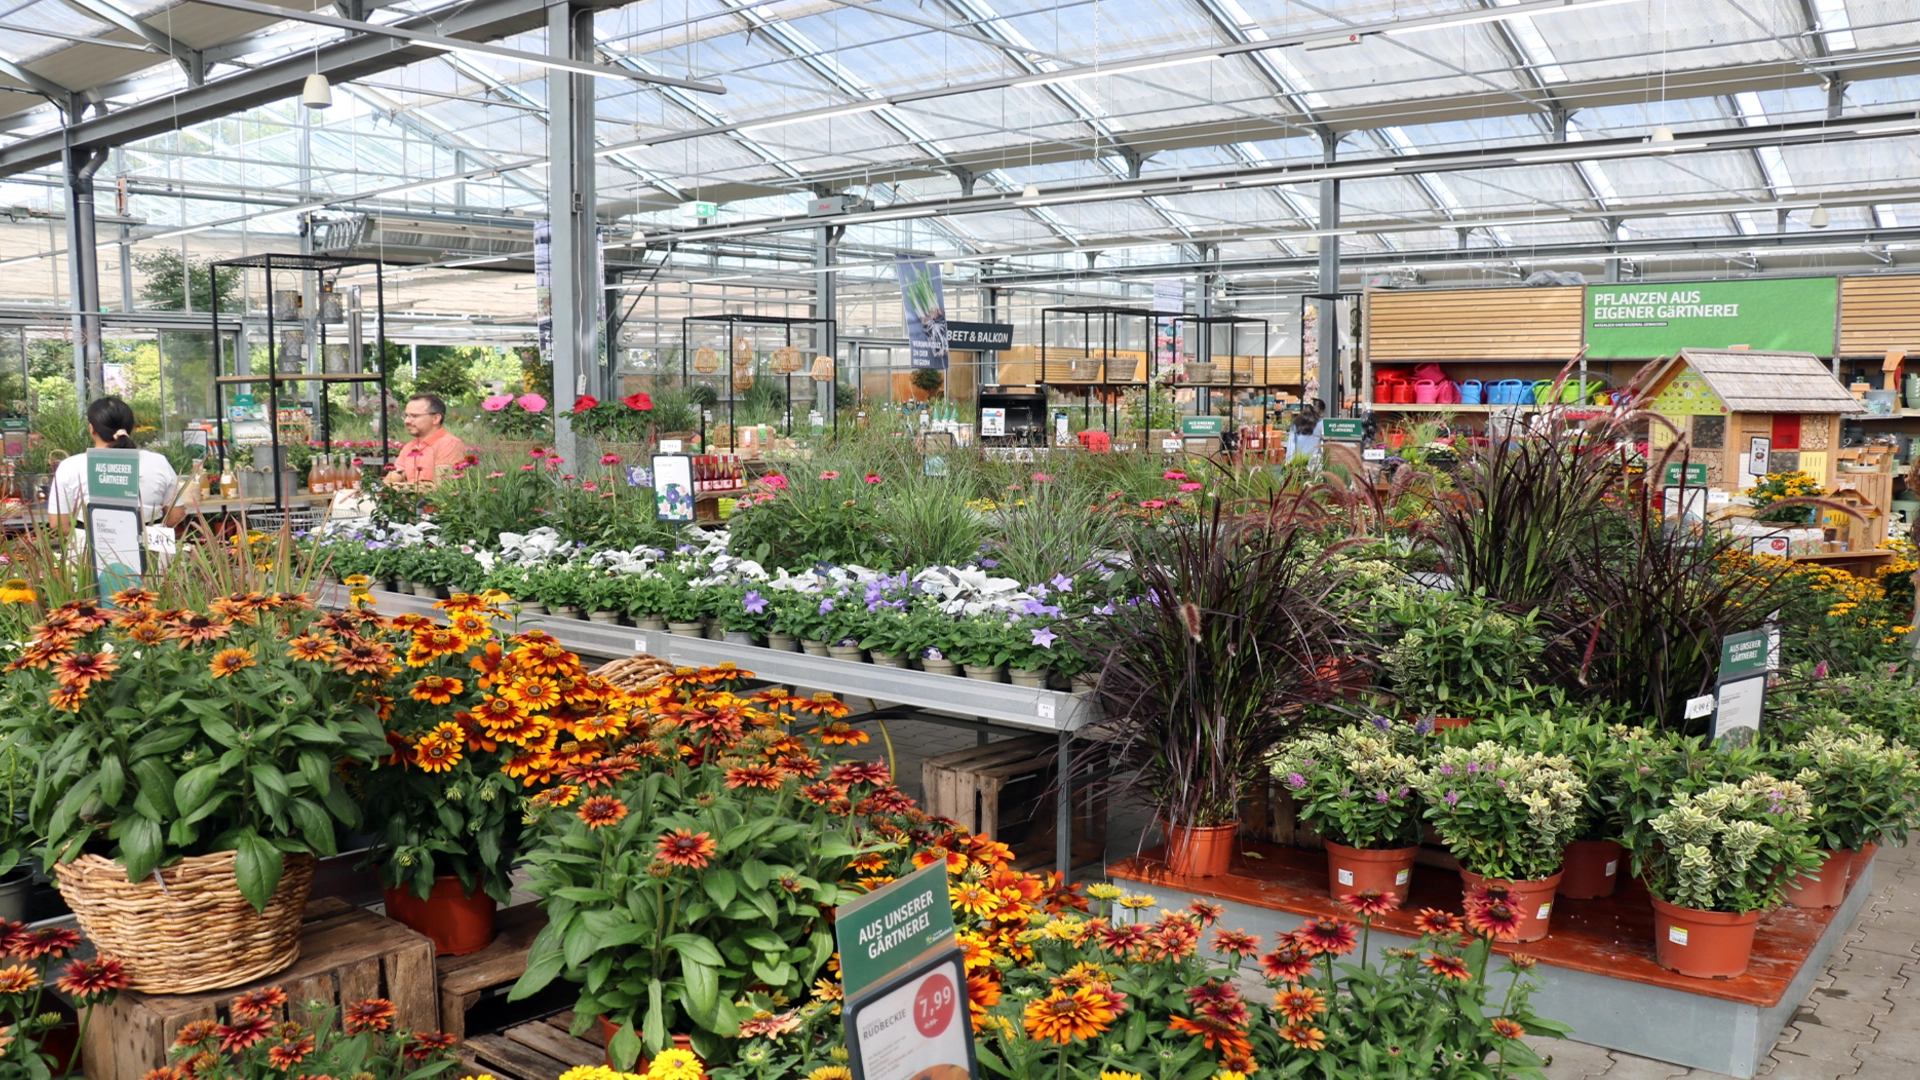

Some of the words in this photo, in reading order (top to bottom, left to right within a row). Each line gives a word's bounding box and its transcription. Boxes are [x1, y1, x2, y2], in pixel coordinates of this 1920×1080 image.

[1595, 292, 1667, 306] PFLANZEN
[1670, 291, 1701, 303] AUS
[1594, 306, 1654, 319] EIGENER
[947, 330, 969, 342] BEET
[970, 331, 976, 342] &
[977, 332, 1009, 343] BALKON
[95, 463, 107, 473] AUS
[107, 463, 132, 474] UNSERER
[98, 473, 129, 485] GÄRTNEREI
[166, 535, 172, 546] €
[1729, 644, 1740, 654] AUS
[1740, 640, 1761, 650] UNSERER
[1731, 650, 1758, 662] GÄRTNEREI
[859, 918, 883, 945] AUS
[884, 890, 934, 930] UNSERER
[868, 911, 931, 959] GÄRTNEREI
[919, 986, 952, 1018] 7,99
[863, 1009, 907, 1041] RUDBECKIE
